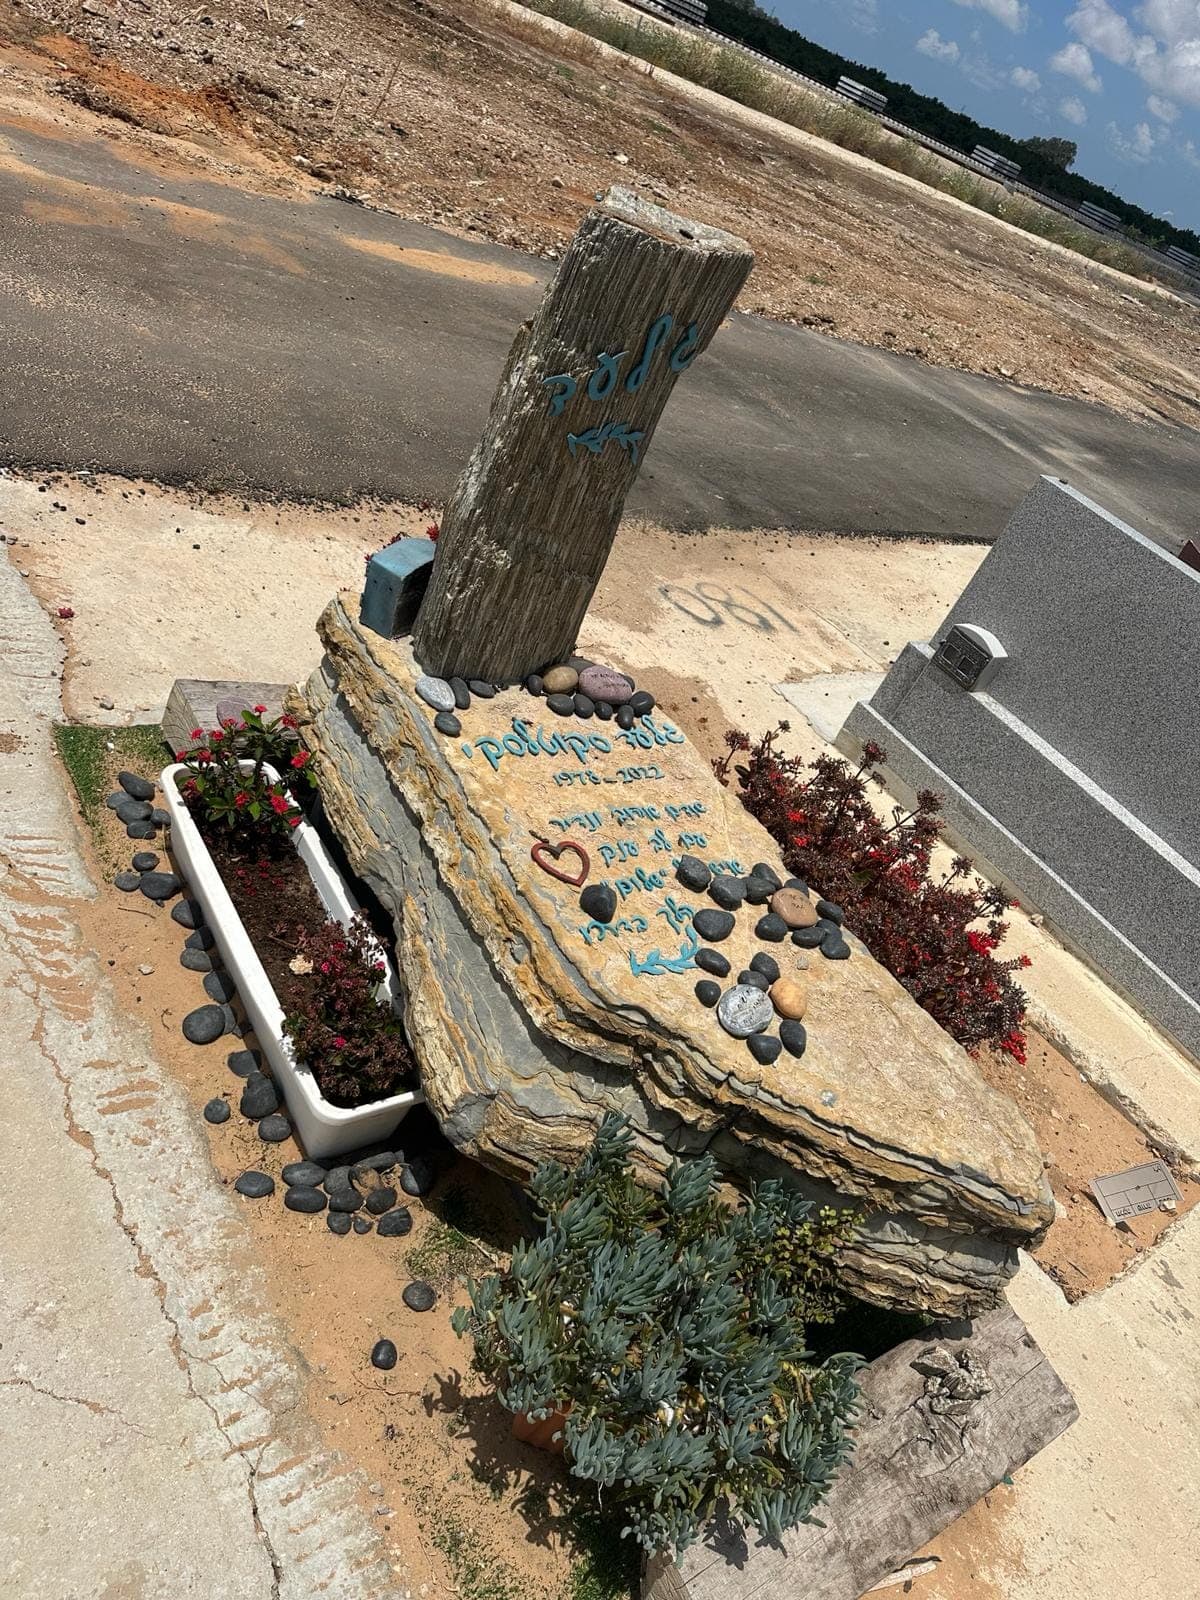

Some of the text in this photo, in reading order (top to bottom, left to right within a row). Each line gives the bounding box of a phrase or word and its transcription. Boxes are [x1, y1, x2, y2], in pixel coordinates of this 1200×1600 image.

[542, 313, 699, 418] גלעד
[615, 714, 685, 749] גלעד
[647, 827, 673, 853] לב
